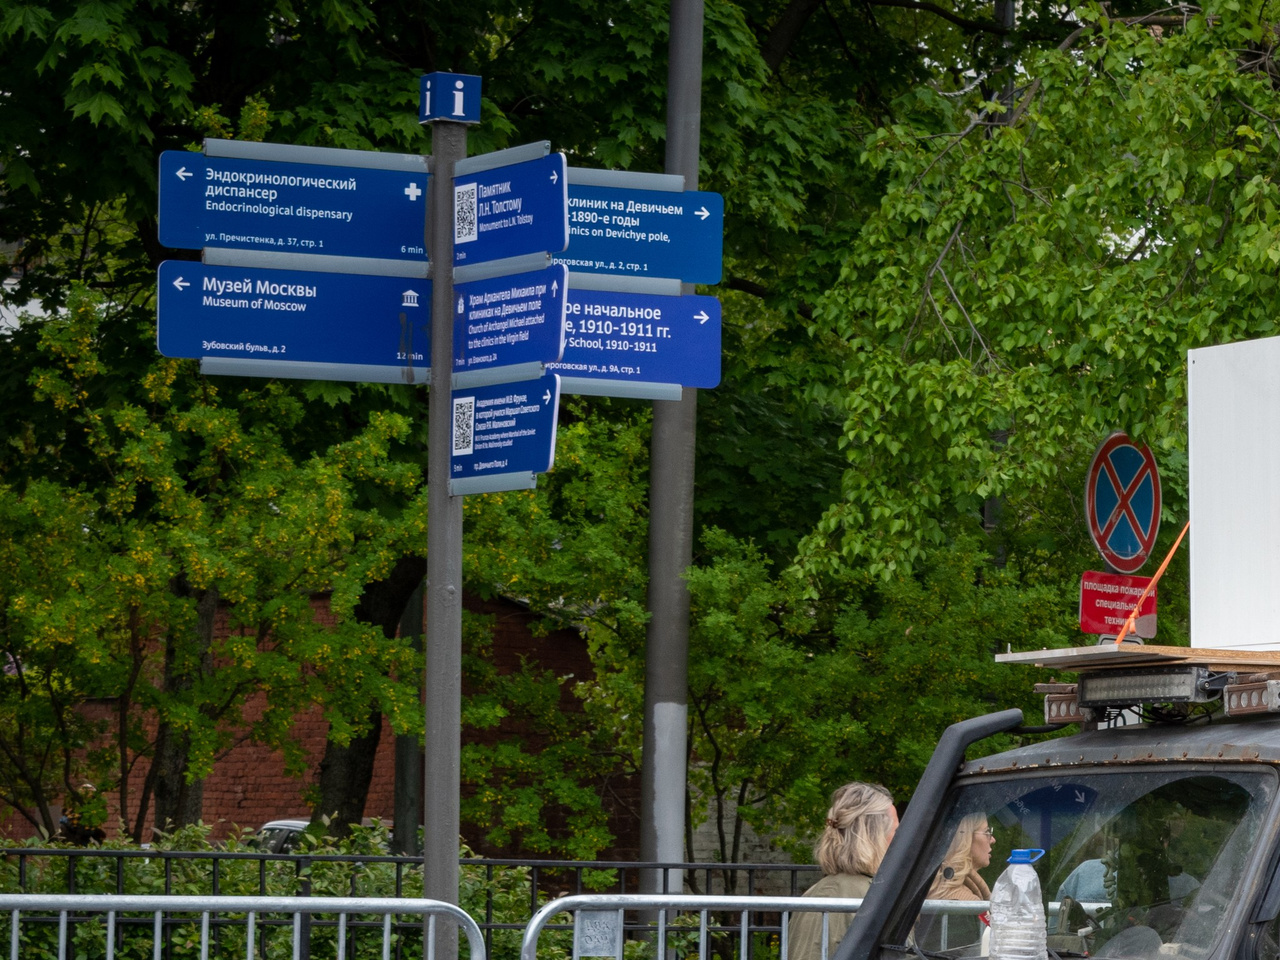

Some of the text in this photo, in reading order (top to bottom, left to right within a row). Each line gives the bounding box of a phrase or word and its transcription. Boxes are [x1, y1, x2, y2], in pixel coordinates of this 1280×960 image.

[205, 167, 357, 191] Эндокринологический
[205, 185, 278, 202] диспансер
[478, 181, 511, 199] Памятник
[205, 200, 353, 222] Endocrinological dispensary
[478, 198, 522, 217] Л.Н. Толстому
[610, 201, 624, 211] на
[626, 200, 684, 215] Девичьем
[479, 219, 503, 232] Monument
[503, 219, 508, 228] to
[517, 214, 533, 225] Tolstoy
[612, 215, 640, 228] годы
[205, 232, 324, 249] ул. Пречистенка, д. 37, стр. 1
[591, 228, 603, 237] on
[605, 228, 647, 241] Devichye
[648, 232, 671, 243] pole,
[401, 245, 424, 254] 6 min
[609, 262, 617, 270] д.
[618, 261, 625, 271] 2,
[626, 263, 642, 272] стр.
[643, 263, 648, 271] 1
[202, 276, 317, 298] Музей Москвы
[202, 295, 307, 312] Museum of Moscow
[469, 284, 546, 308] Храм Архангела Михаила при
[494, 306, 501, 316] на
[501, 301, 527, 317] Девичьем
[528, 299, 541, 311] поле
[584, 304, 661, 320] начальное
[468, 323, 483, 335] Church
[483, 321, 488, 332] of
[525, 313, 545, 326] attached
[579, 319, 653, 337] 1910-1911
[657, 326, 671, 339] гг.
[202, 340, 244, 351] Зубовский
[280, 345, 286, 353] 2
[569, 337, 604, 351] School,
[605, 340, 657, 353] 1910-1911
[396, 352, 424, 360] 12 min
[620, 366, 635, 375] стр.
[636, 366, 641, 374] 1
[1083, 581, 1119, 594] площадка
